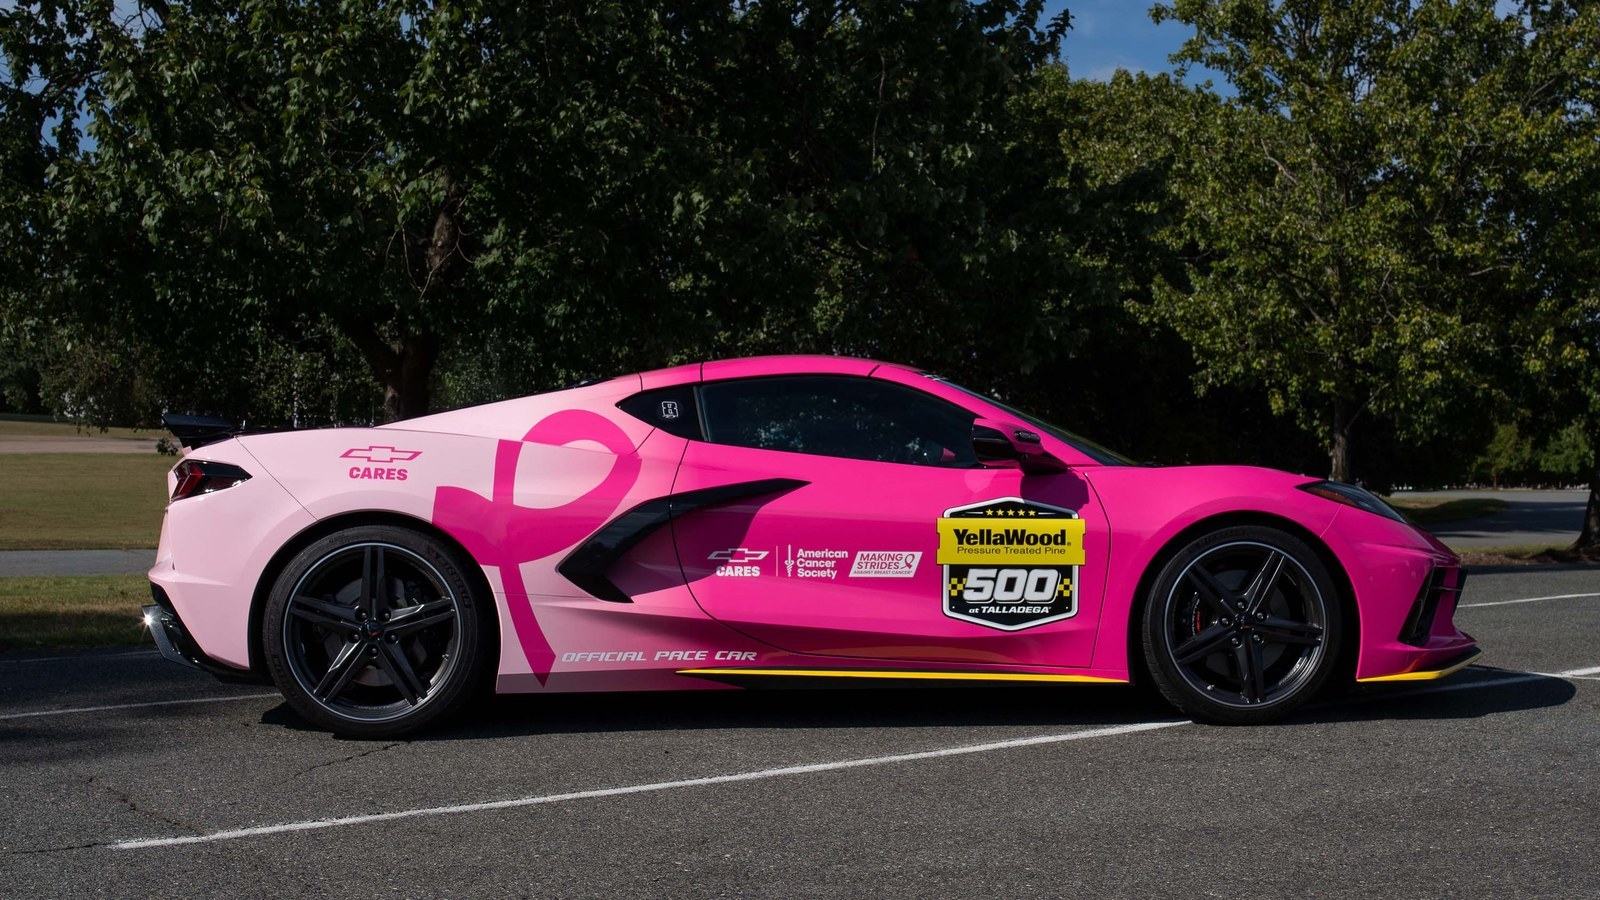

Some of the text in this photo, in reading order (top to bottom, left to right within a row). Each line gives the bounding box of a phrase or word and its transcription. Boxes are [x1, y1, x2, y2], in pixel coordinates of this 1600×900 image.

[349, 466, 408, 481] CARES
[797, 548, 848, 558] American
[957, 547, 1066, 555] Pressure Treated Pine
[860, 553, 903, 561] MAKING
[796, 558, 836, 567] Cancer
[857, 562, 899, 570] STRIDES
[716, 565, 760, 577] CARES
[797, 568, 837, 579] Society
[963, 568, 1060, 602] 500
[981, 606, 1049, 614] TALLADEGA
[561, 650, 757, 663] OFFICIAL PACE CAR
